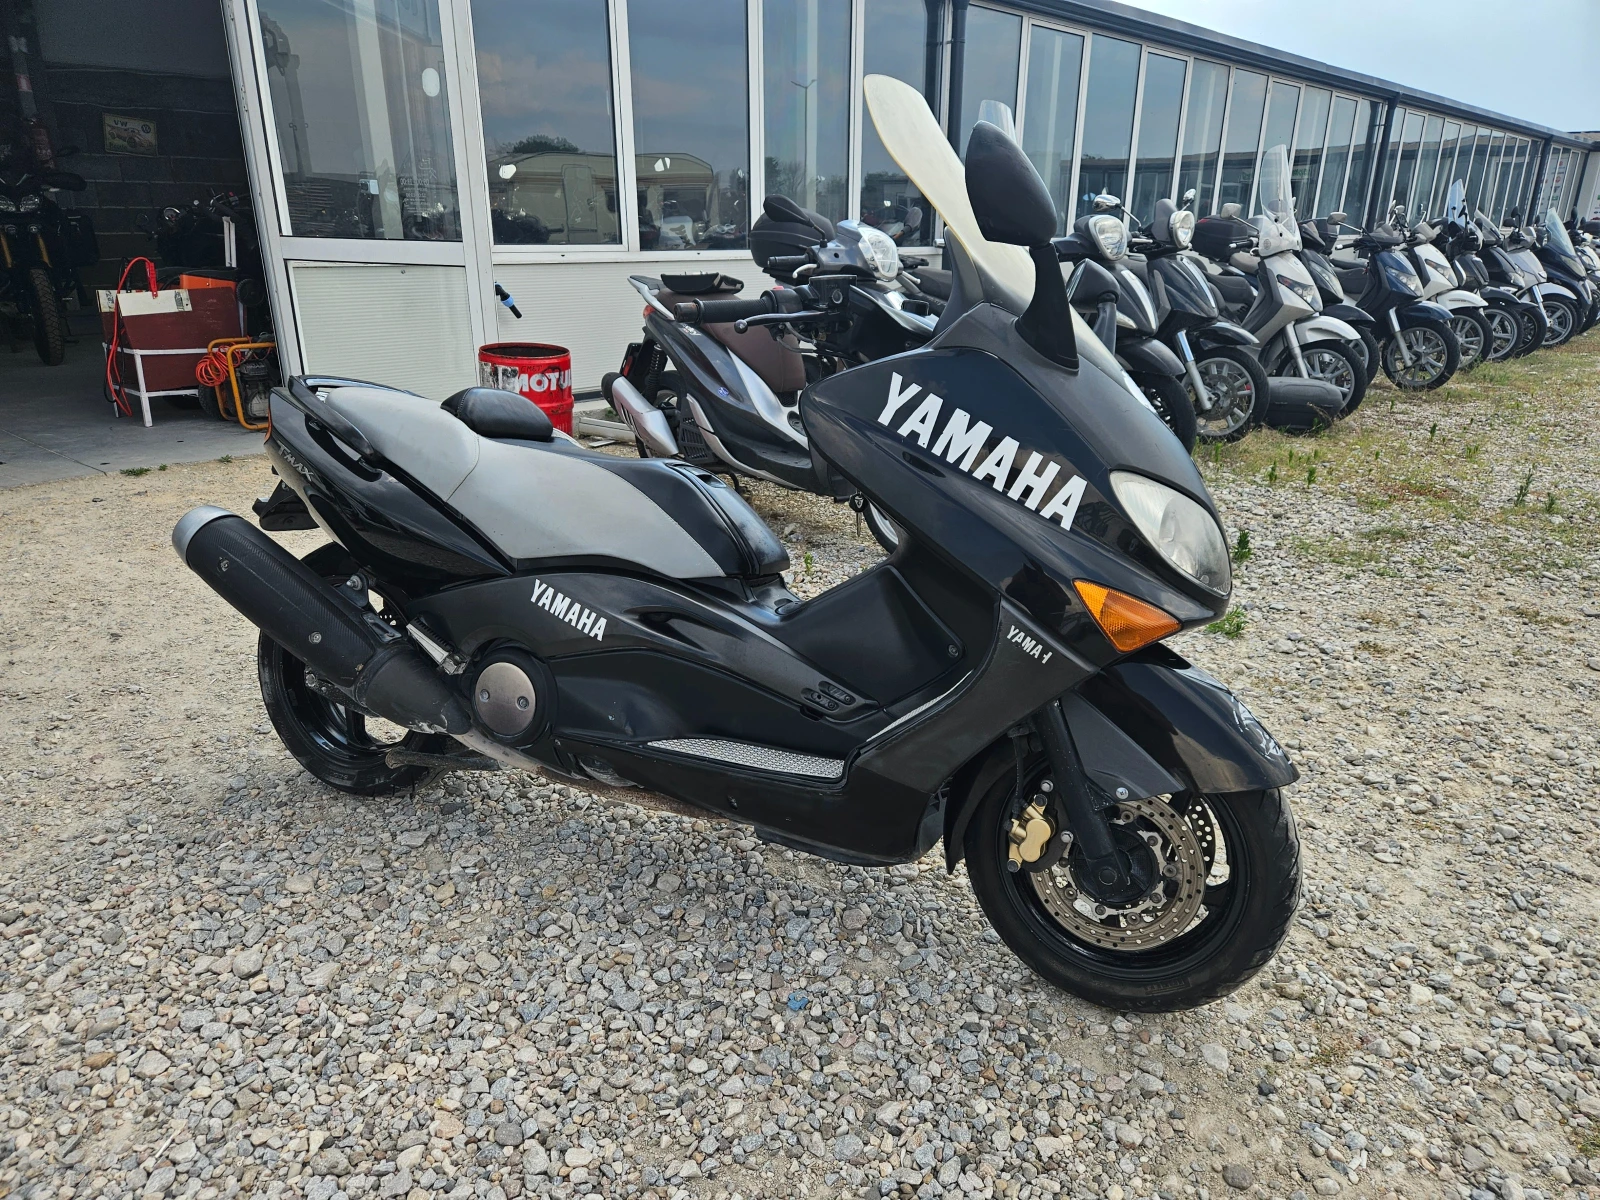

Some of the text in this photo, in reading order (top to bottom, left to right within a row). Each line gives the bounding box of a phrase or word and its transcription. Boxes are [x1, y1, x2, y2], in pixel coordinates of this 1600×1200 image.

[277, 440, 314, 481] TMAX
[876, 371, 1088, 532] YAMAHA
[530, 578, 608, 642] YAMAHA
